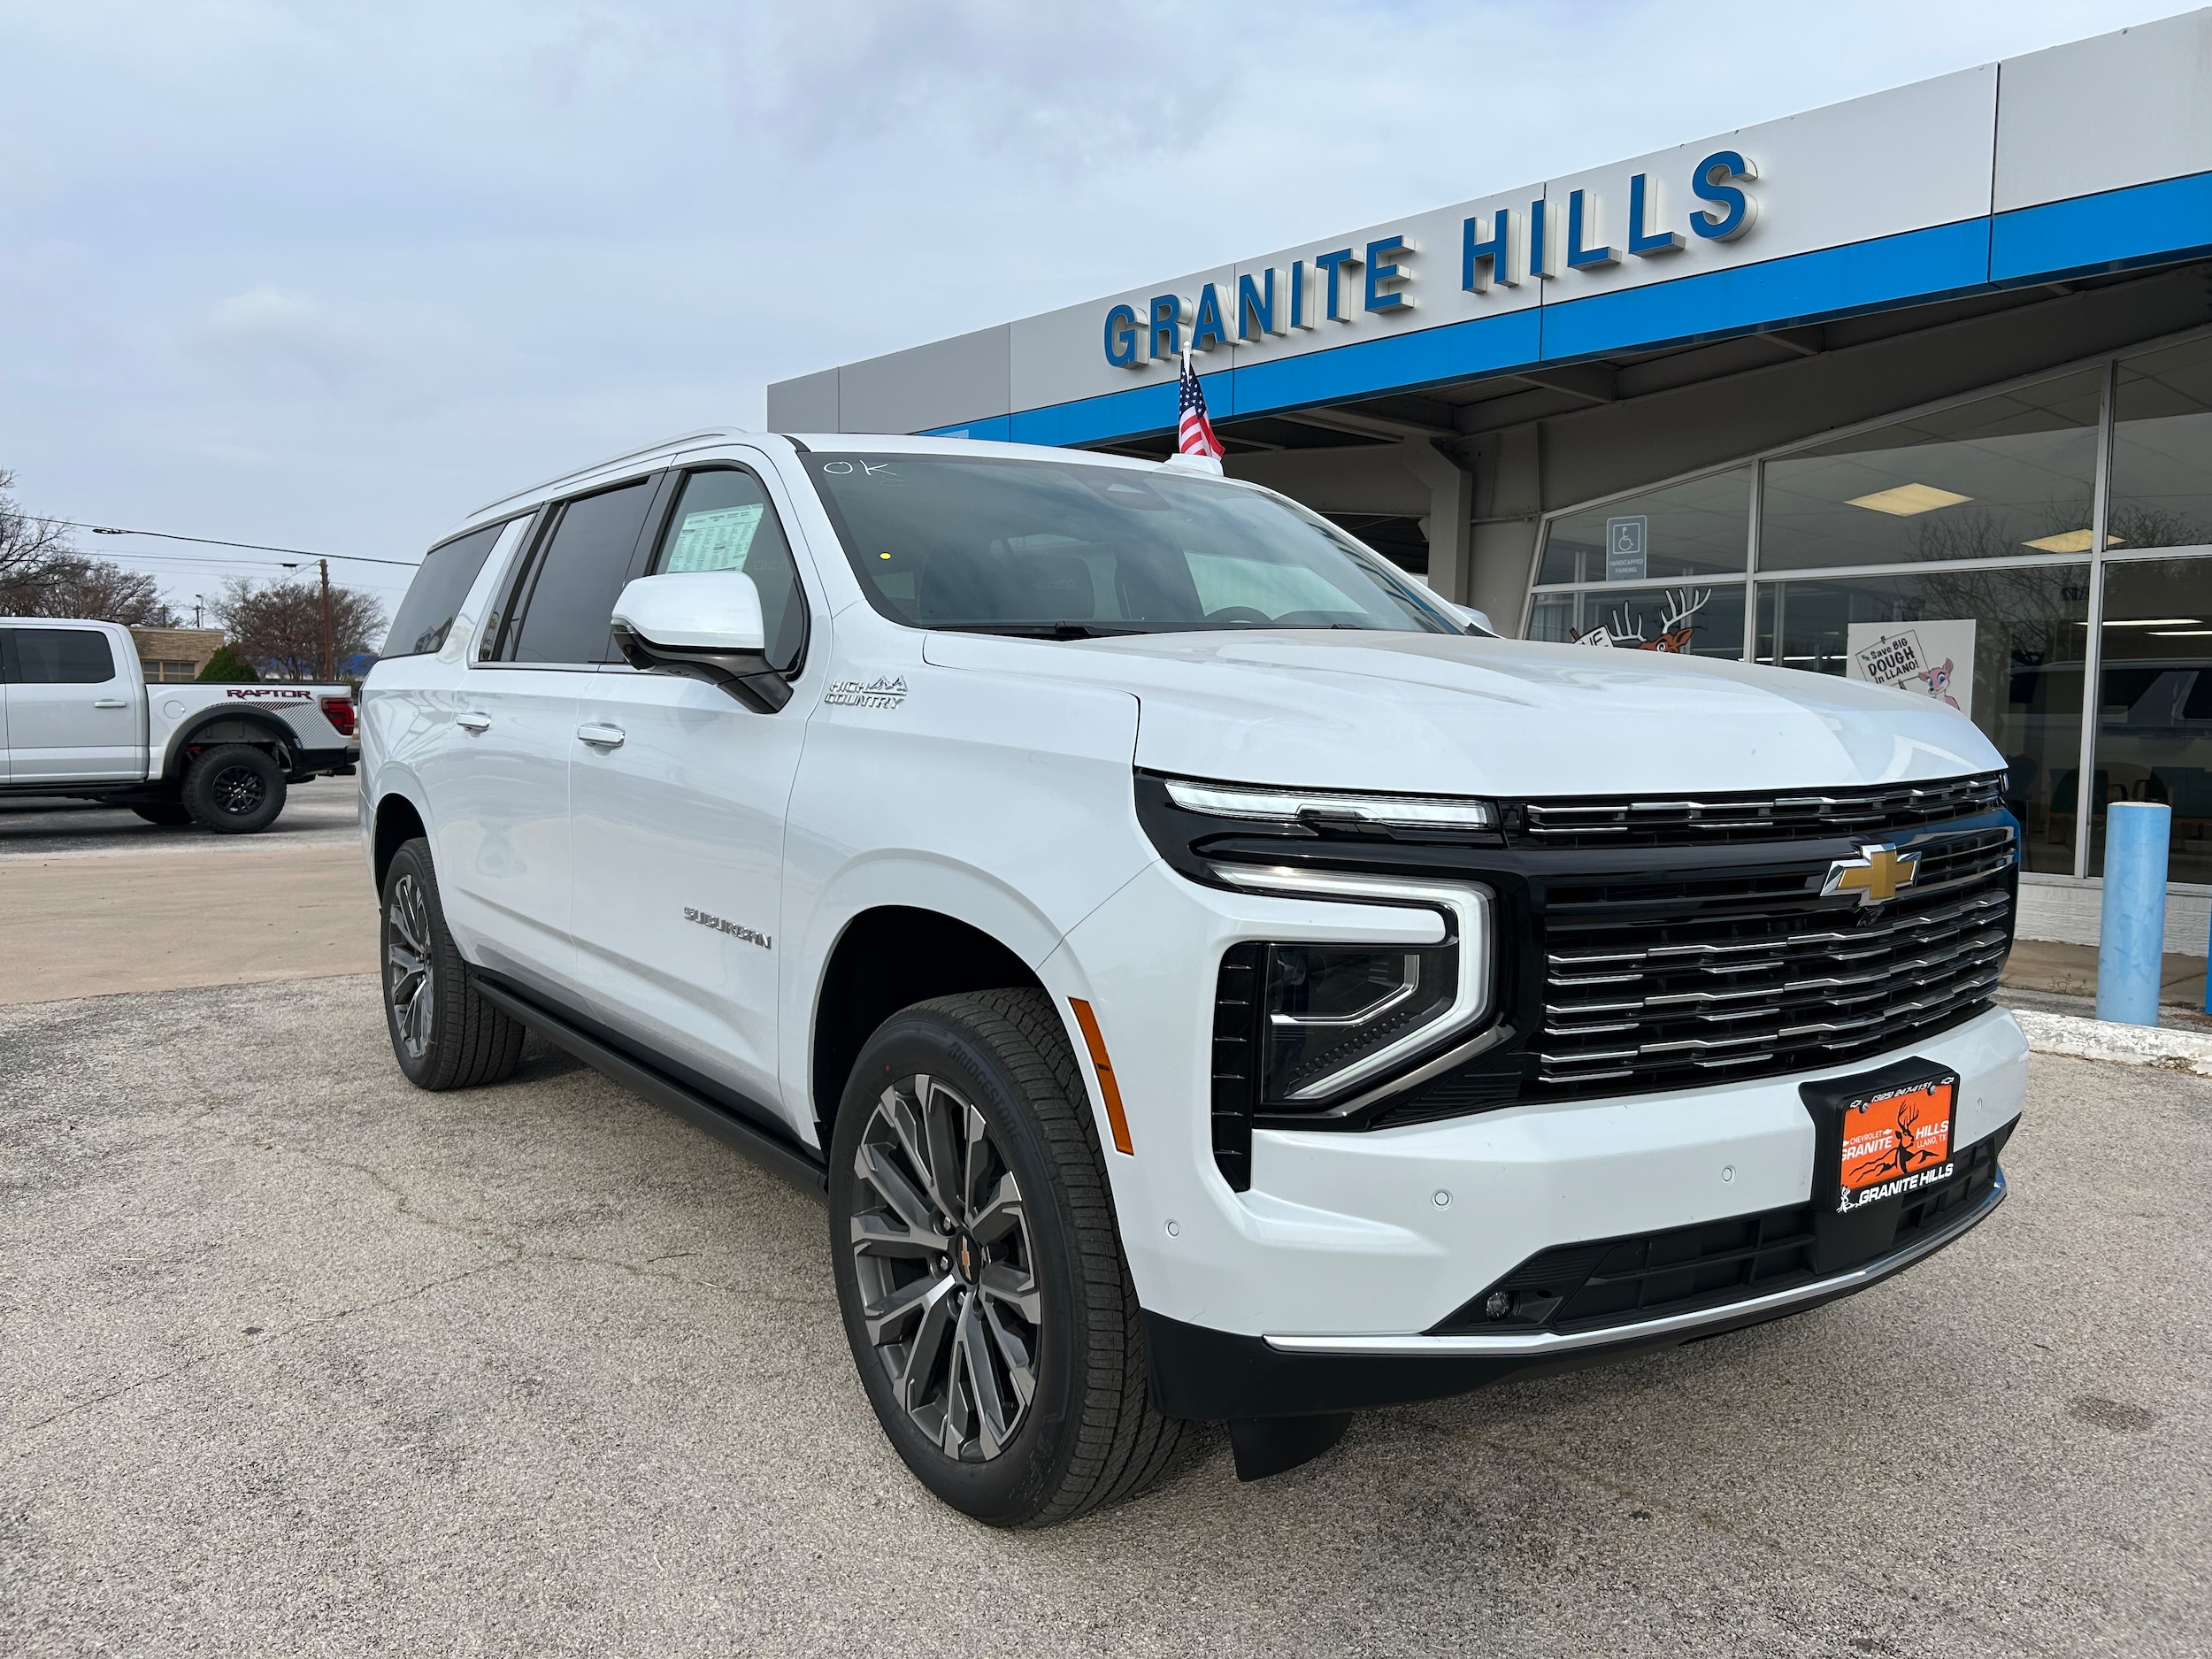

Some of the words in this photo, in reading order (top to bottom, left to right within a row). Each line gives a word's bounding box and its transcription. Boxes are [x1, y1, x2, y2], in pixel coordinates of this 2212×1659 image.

[1104, 234, 1414, 368] GRANITE
[1463, 150, 1757, 293] HILLS
[824, 459, 898, 476] OK
[1870, 647, 1892, 660] Save
[1892, 638, 1909, 651] BIG
[1867, 646, 1916, 677] DOUGH
[1874, 674, 1886, 685] in
[1885, 659, 1920, 680] LLANO!
[227, 689, 315, 700] RAPTOR
[830, 680, 871, 693] HIGH
[825, 693, 904, 709] COUNTRY
[684, 907, 772, 949] SUBURBAN
[1871, 1091, 1895, 1102] (325)
[1893, 1081, 1932, 1096] 247-4151
[1849, 1130, 1882, 1145] CHEVROLET
[1915, 1120, 1949, 1141] HILLS
[1916, 1137, 1938, 1148] LLANO,
[1859, 1174, 1919, 1204] GRANITE
[1919, 1163, 1954, 1186] HILLS
